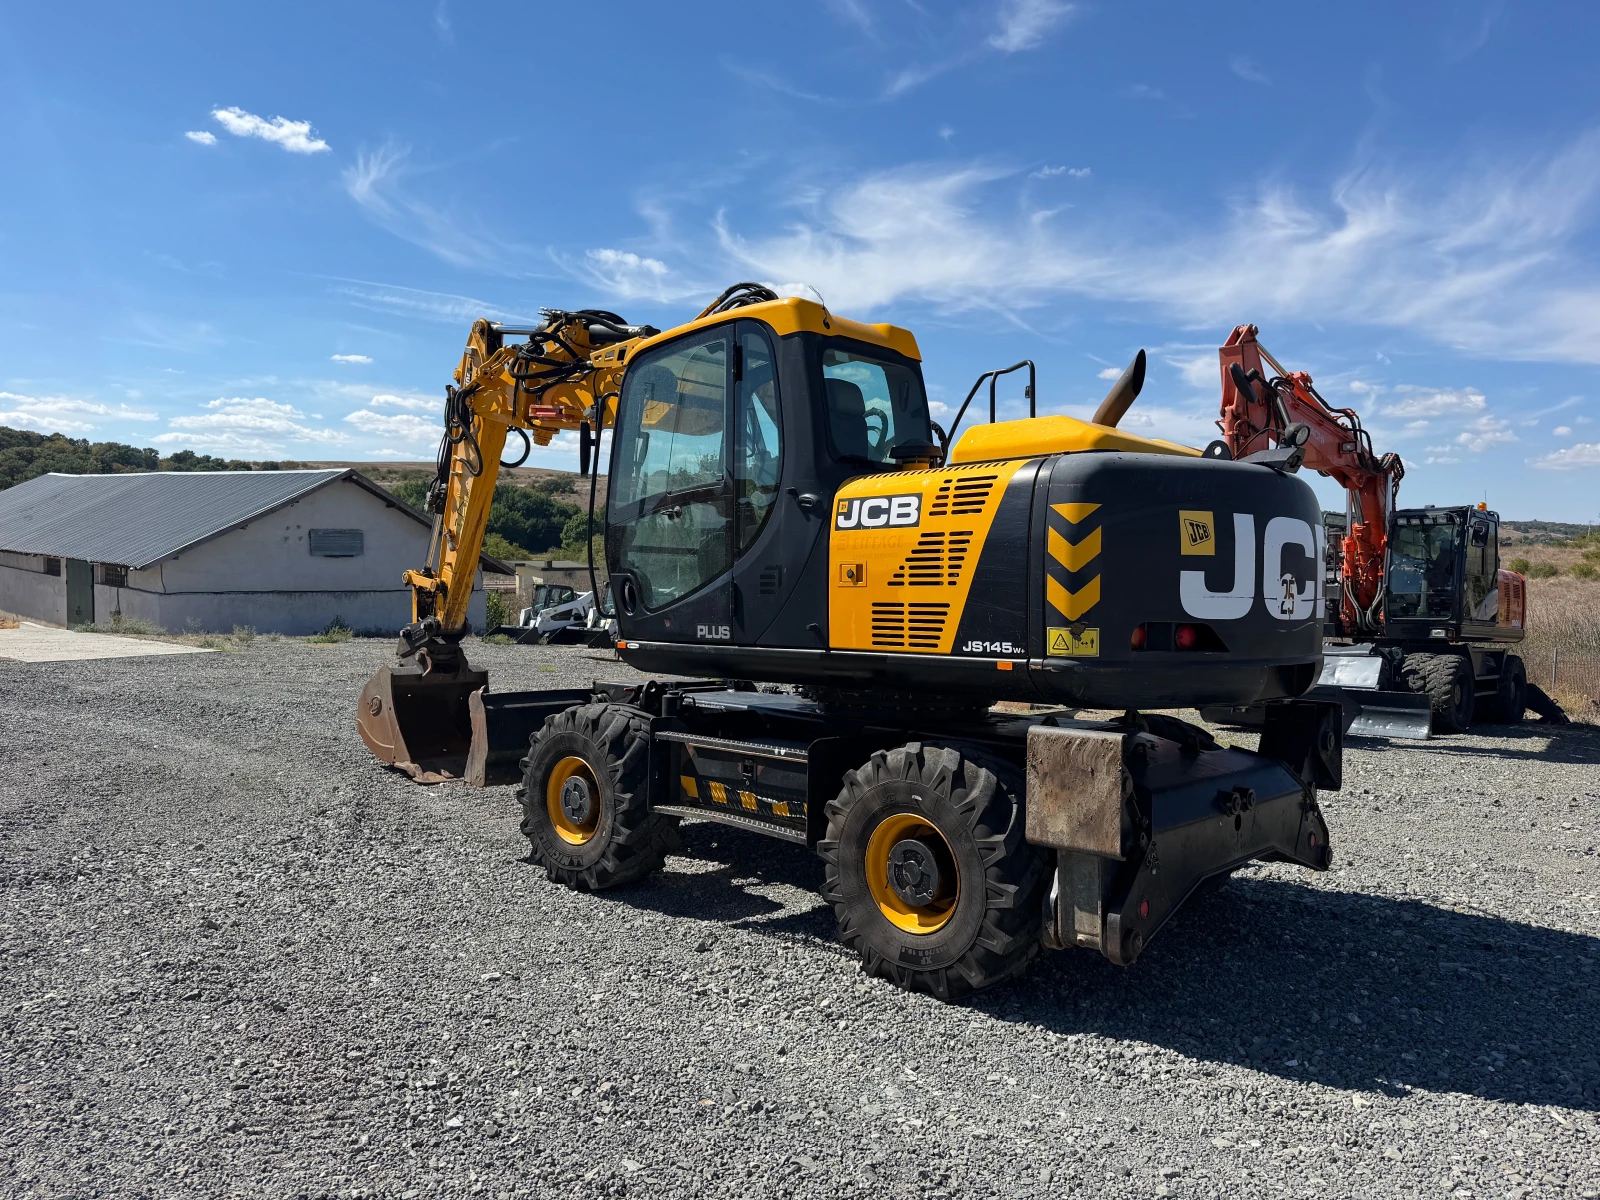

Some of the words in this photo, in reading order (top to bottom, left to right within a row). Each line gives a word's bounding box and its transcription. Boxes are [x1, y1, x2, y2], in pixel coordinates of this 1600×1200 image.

[837, 496, 919, 528] JCB
[1189, 521, 1211, 543] JCB
[697, 625, 731, 639] PLUS
